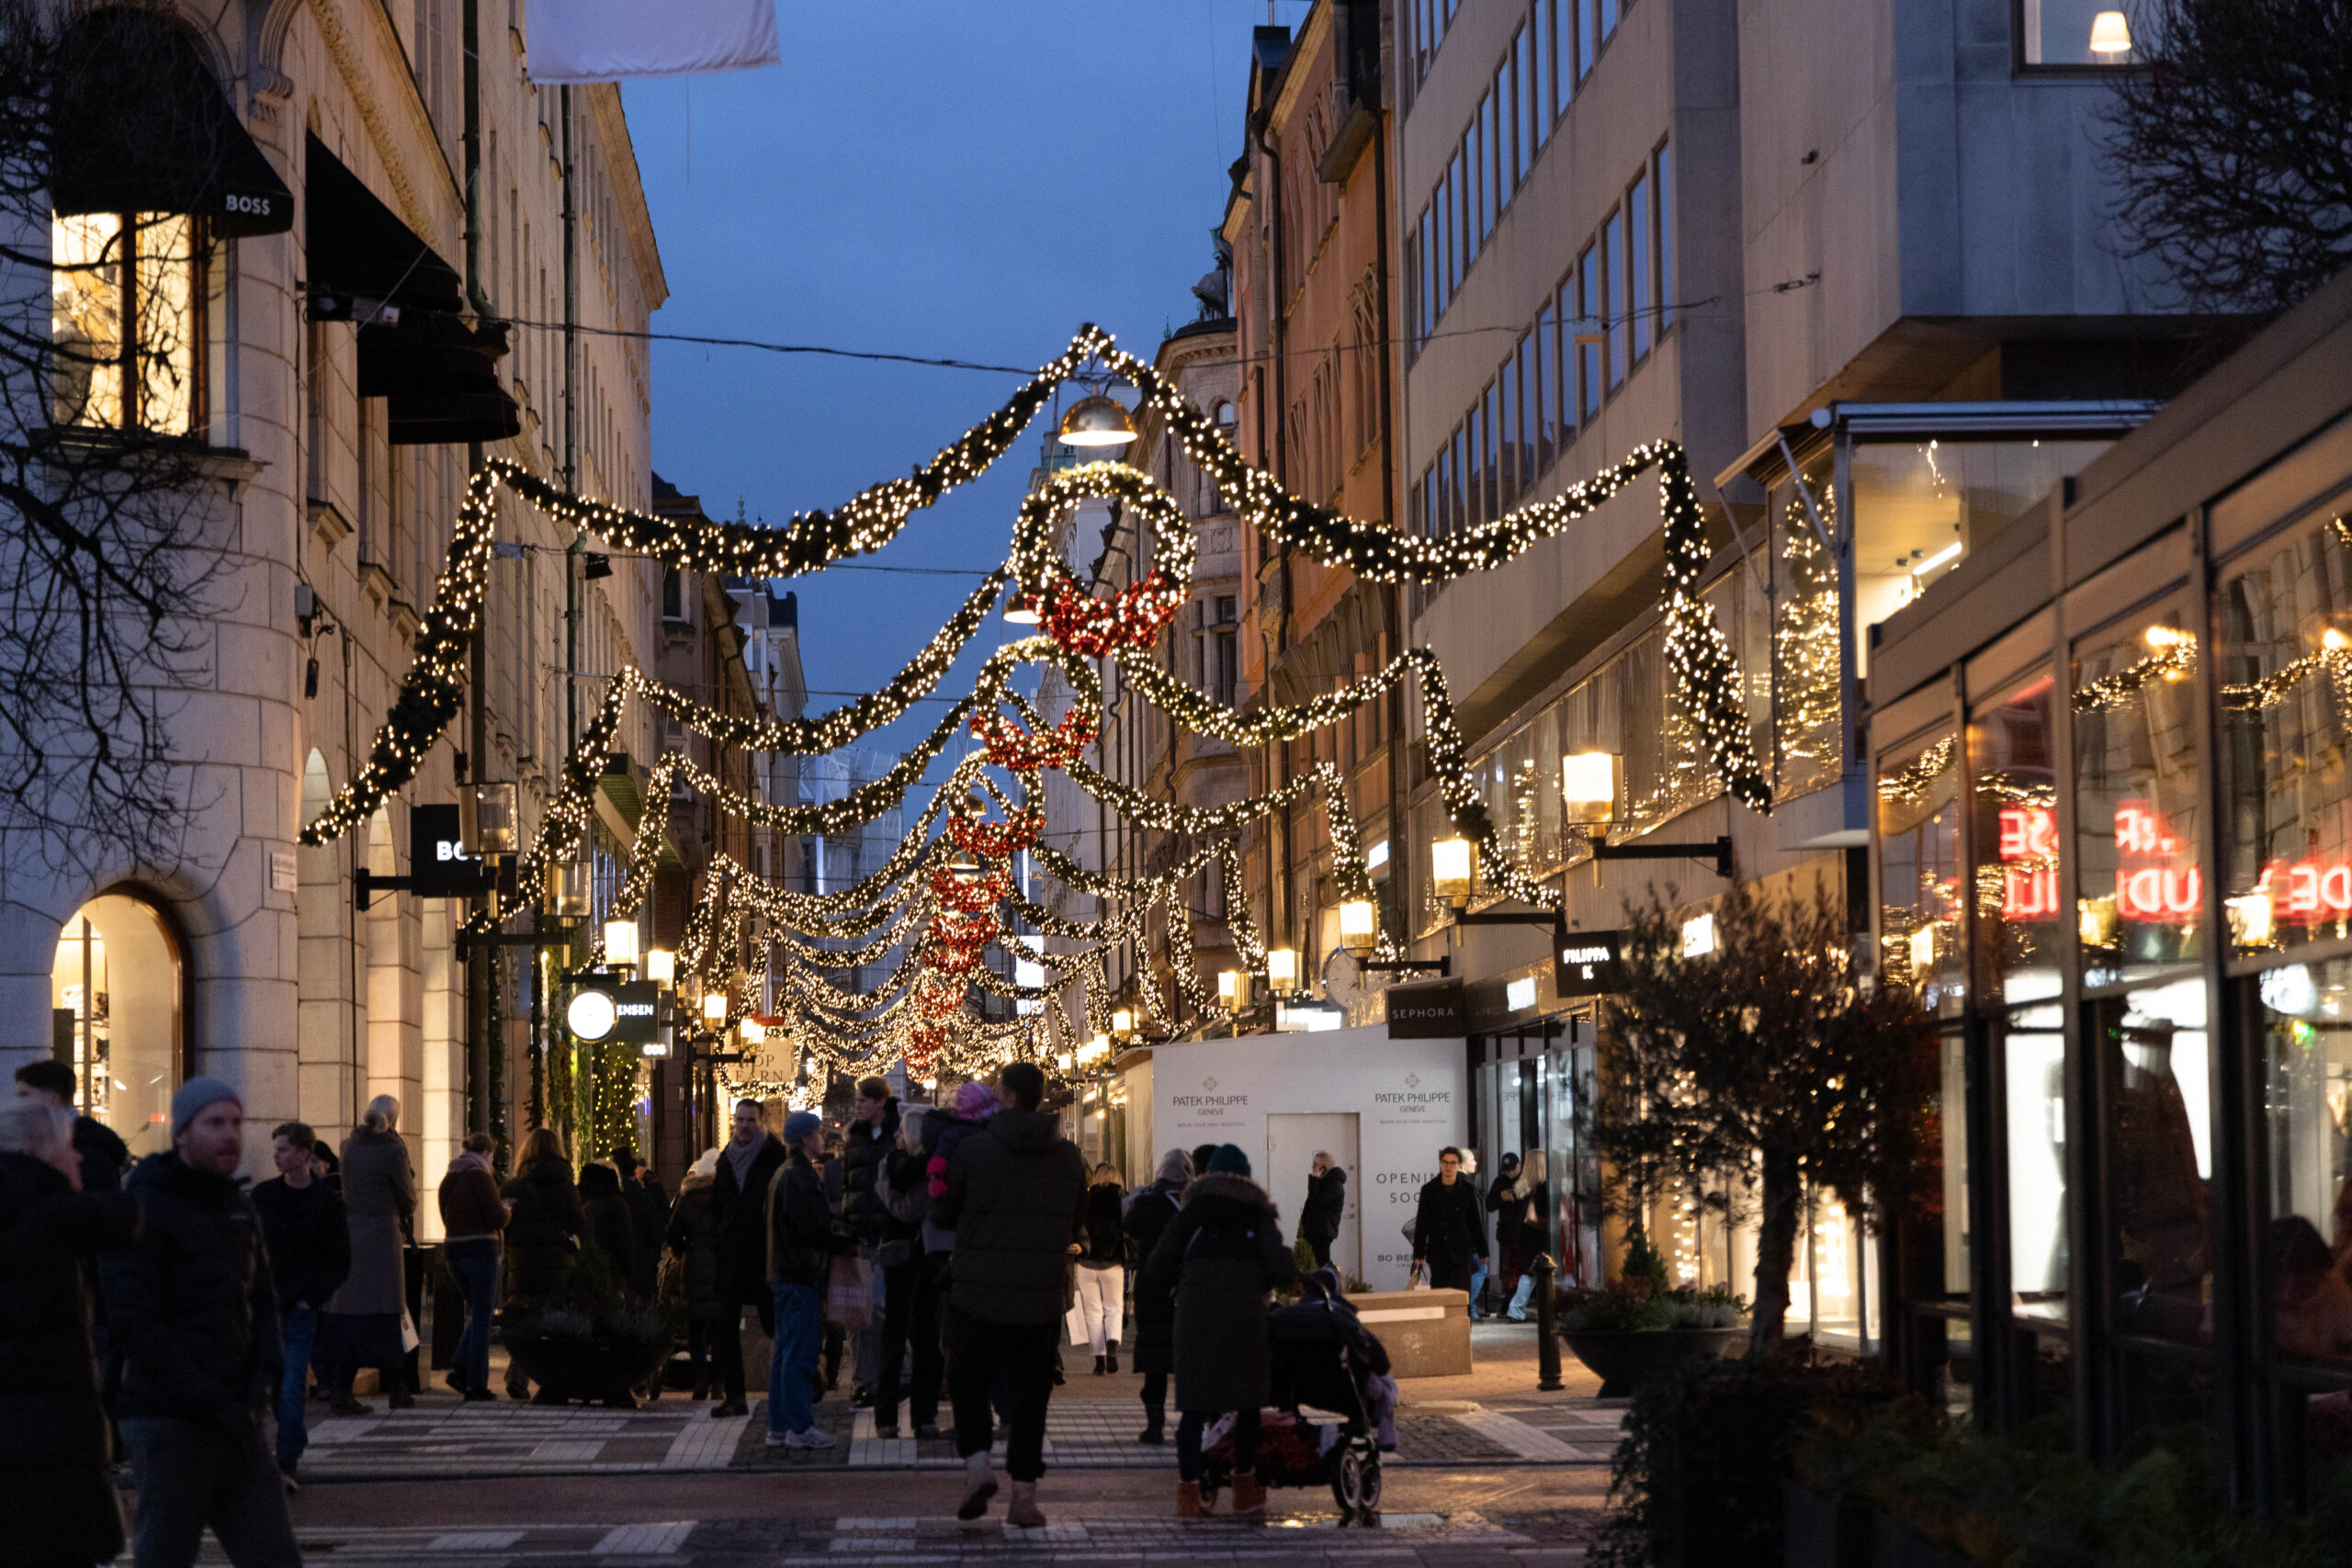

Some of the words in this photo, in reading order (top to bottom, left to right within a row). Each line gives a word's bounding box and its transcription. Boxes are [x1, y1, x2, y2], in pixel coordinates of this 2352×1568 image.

[225, 194, 272, 216] BOSS
[436, 840, 482, 861] BO
[1563, 947, 1610, 964] FILIPPA
[1582, 964, 1594, 979] K
[616, 1004, 653, 1016] ENSEN
[1392, 1007, 1454, 1019] SEPHORA
[1172, 1096, 1203, 1106] PATEK
[1205, 1095, 1249, 1106] PHILIPPE
[1375, 1093, 1405, 1103] PATEK
[1408, 1092, 1451, 1102] PHILIPPE
[1376, 1173, 1438, 1185] OPENIN
